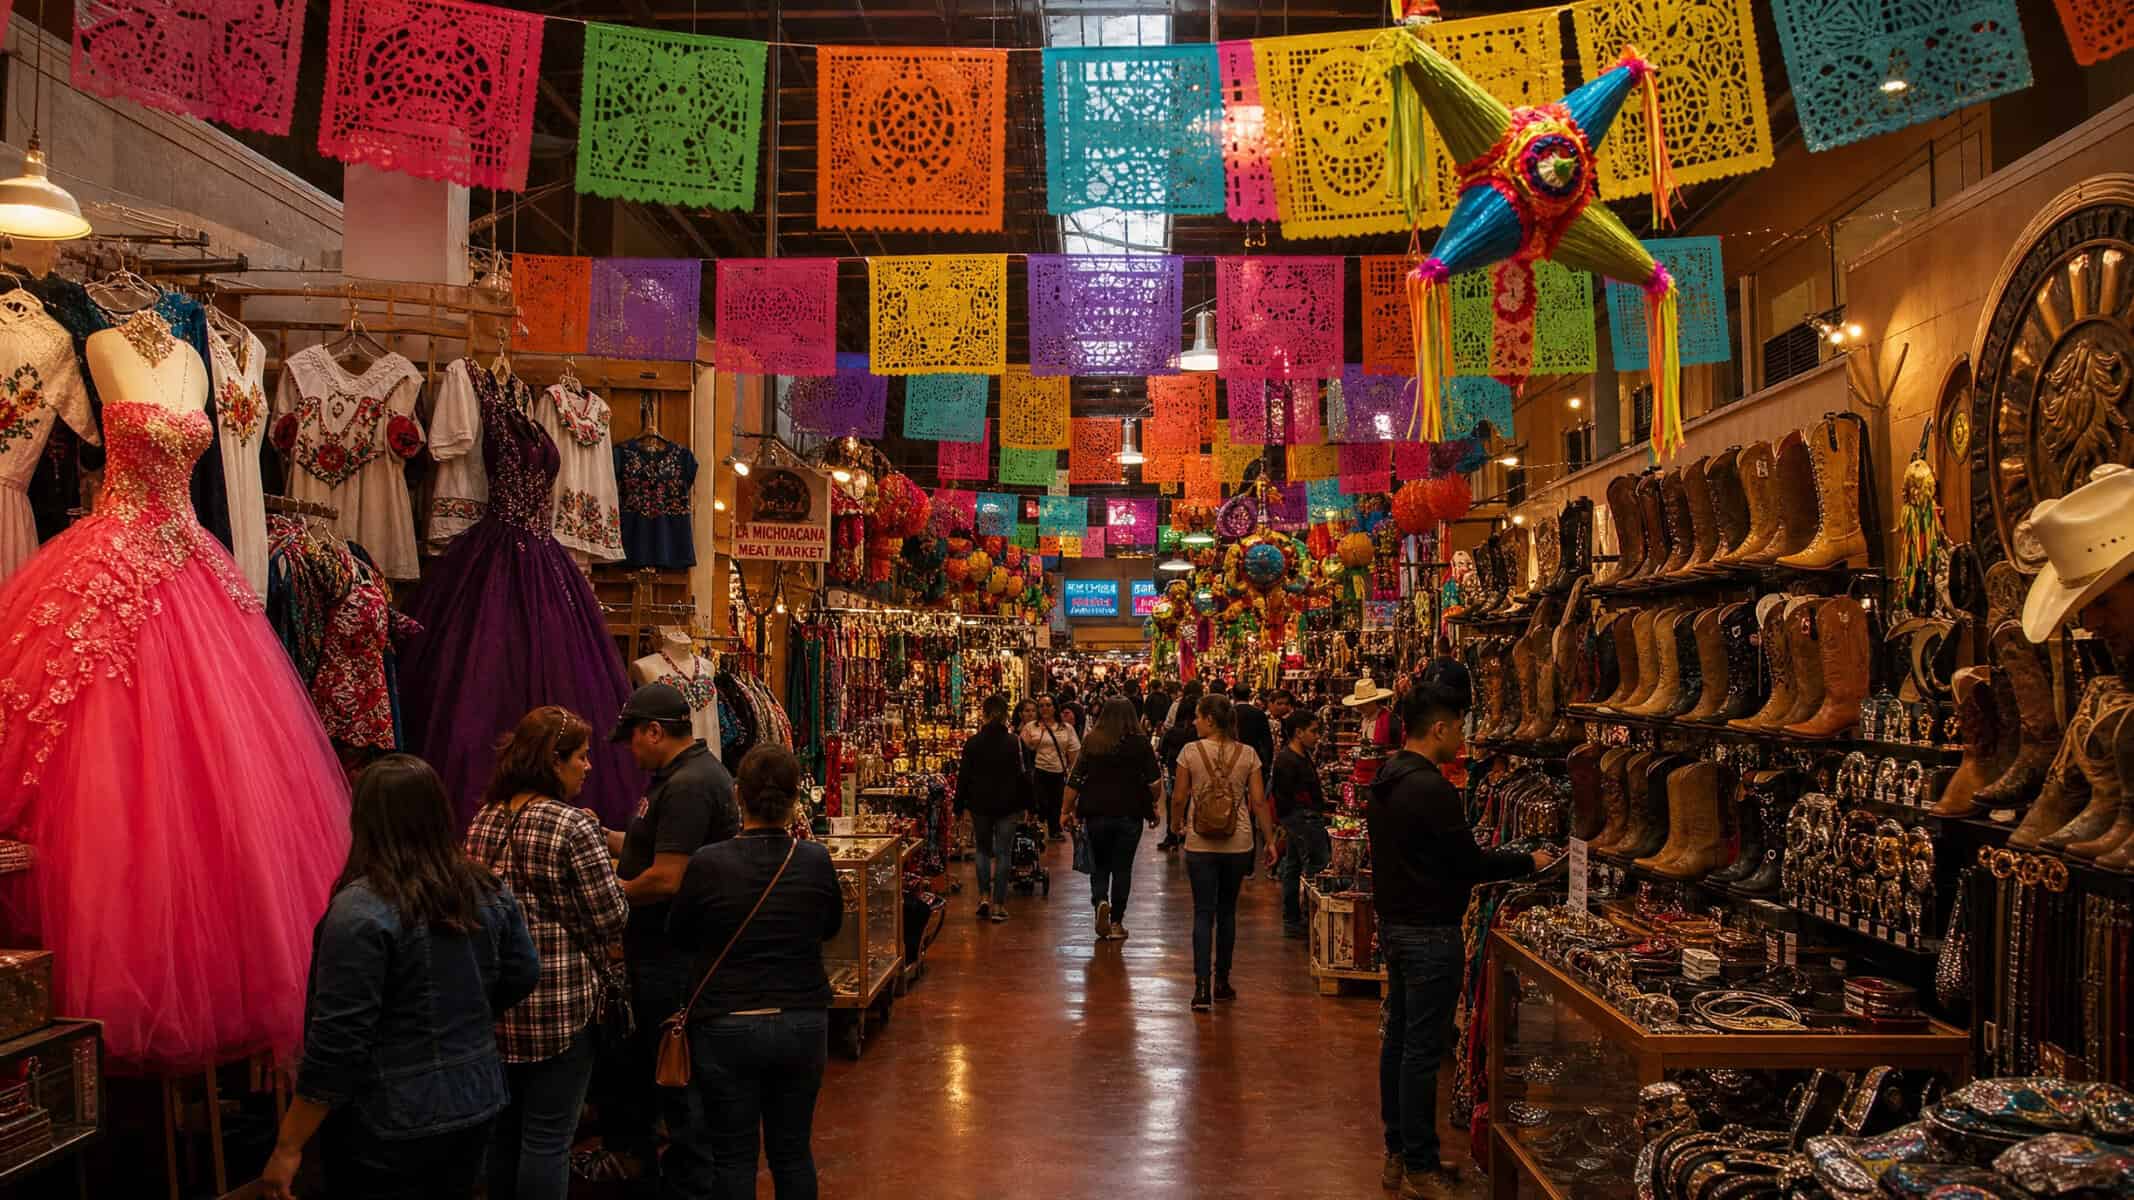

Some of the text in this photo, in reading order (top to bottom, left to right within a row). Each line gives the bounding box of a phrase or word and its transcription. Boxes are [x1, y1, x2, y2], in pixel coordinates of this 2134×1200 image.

[753, 526, 825, 542] MICHOACANA
[738, 544, 824, 558] MEAT MARKET
